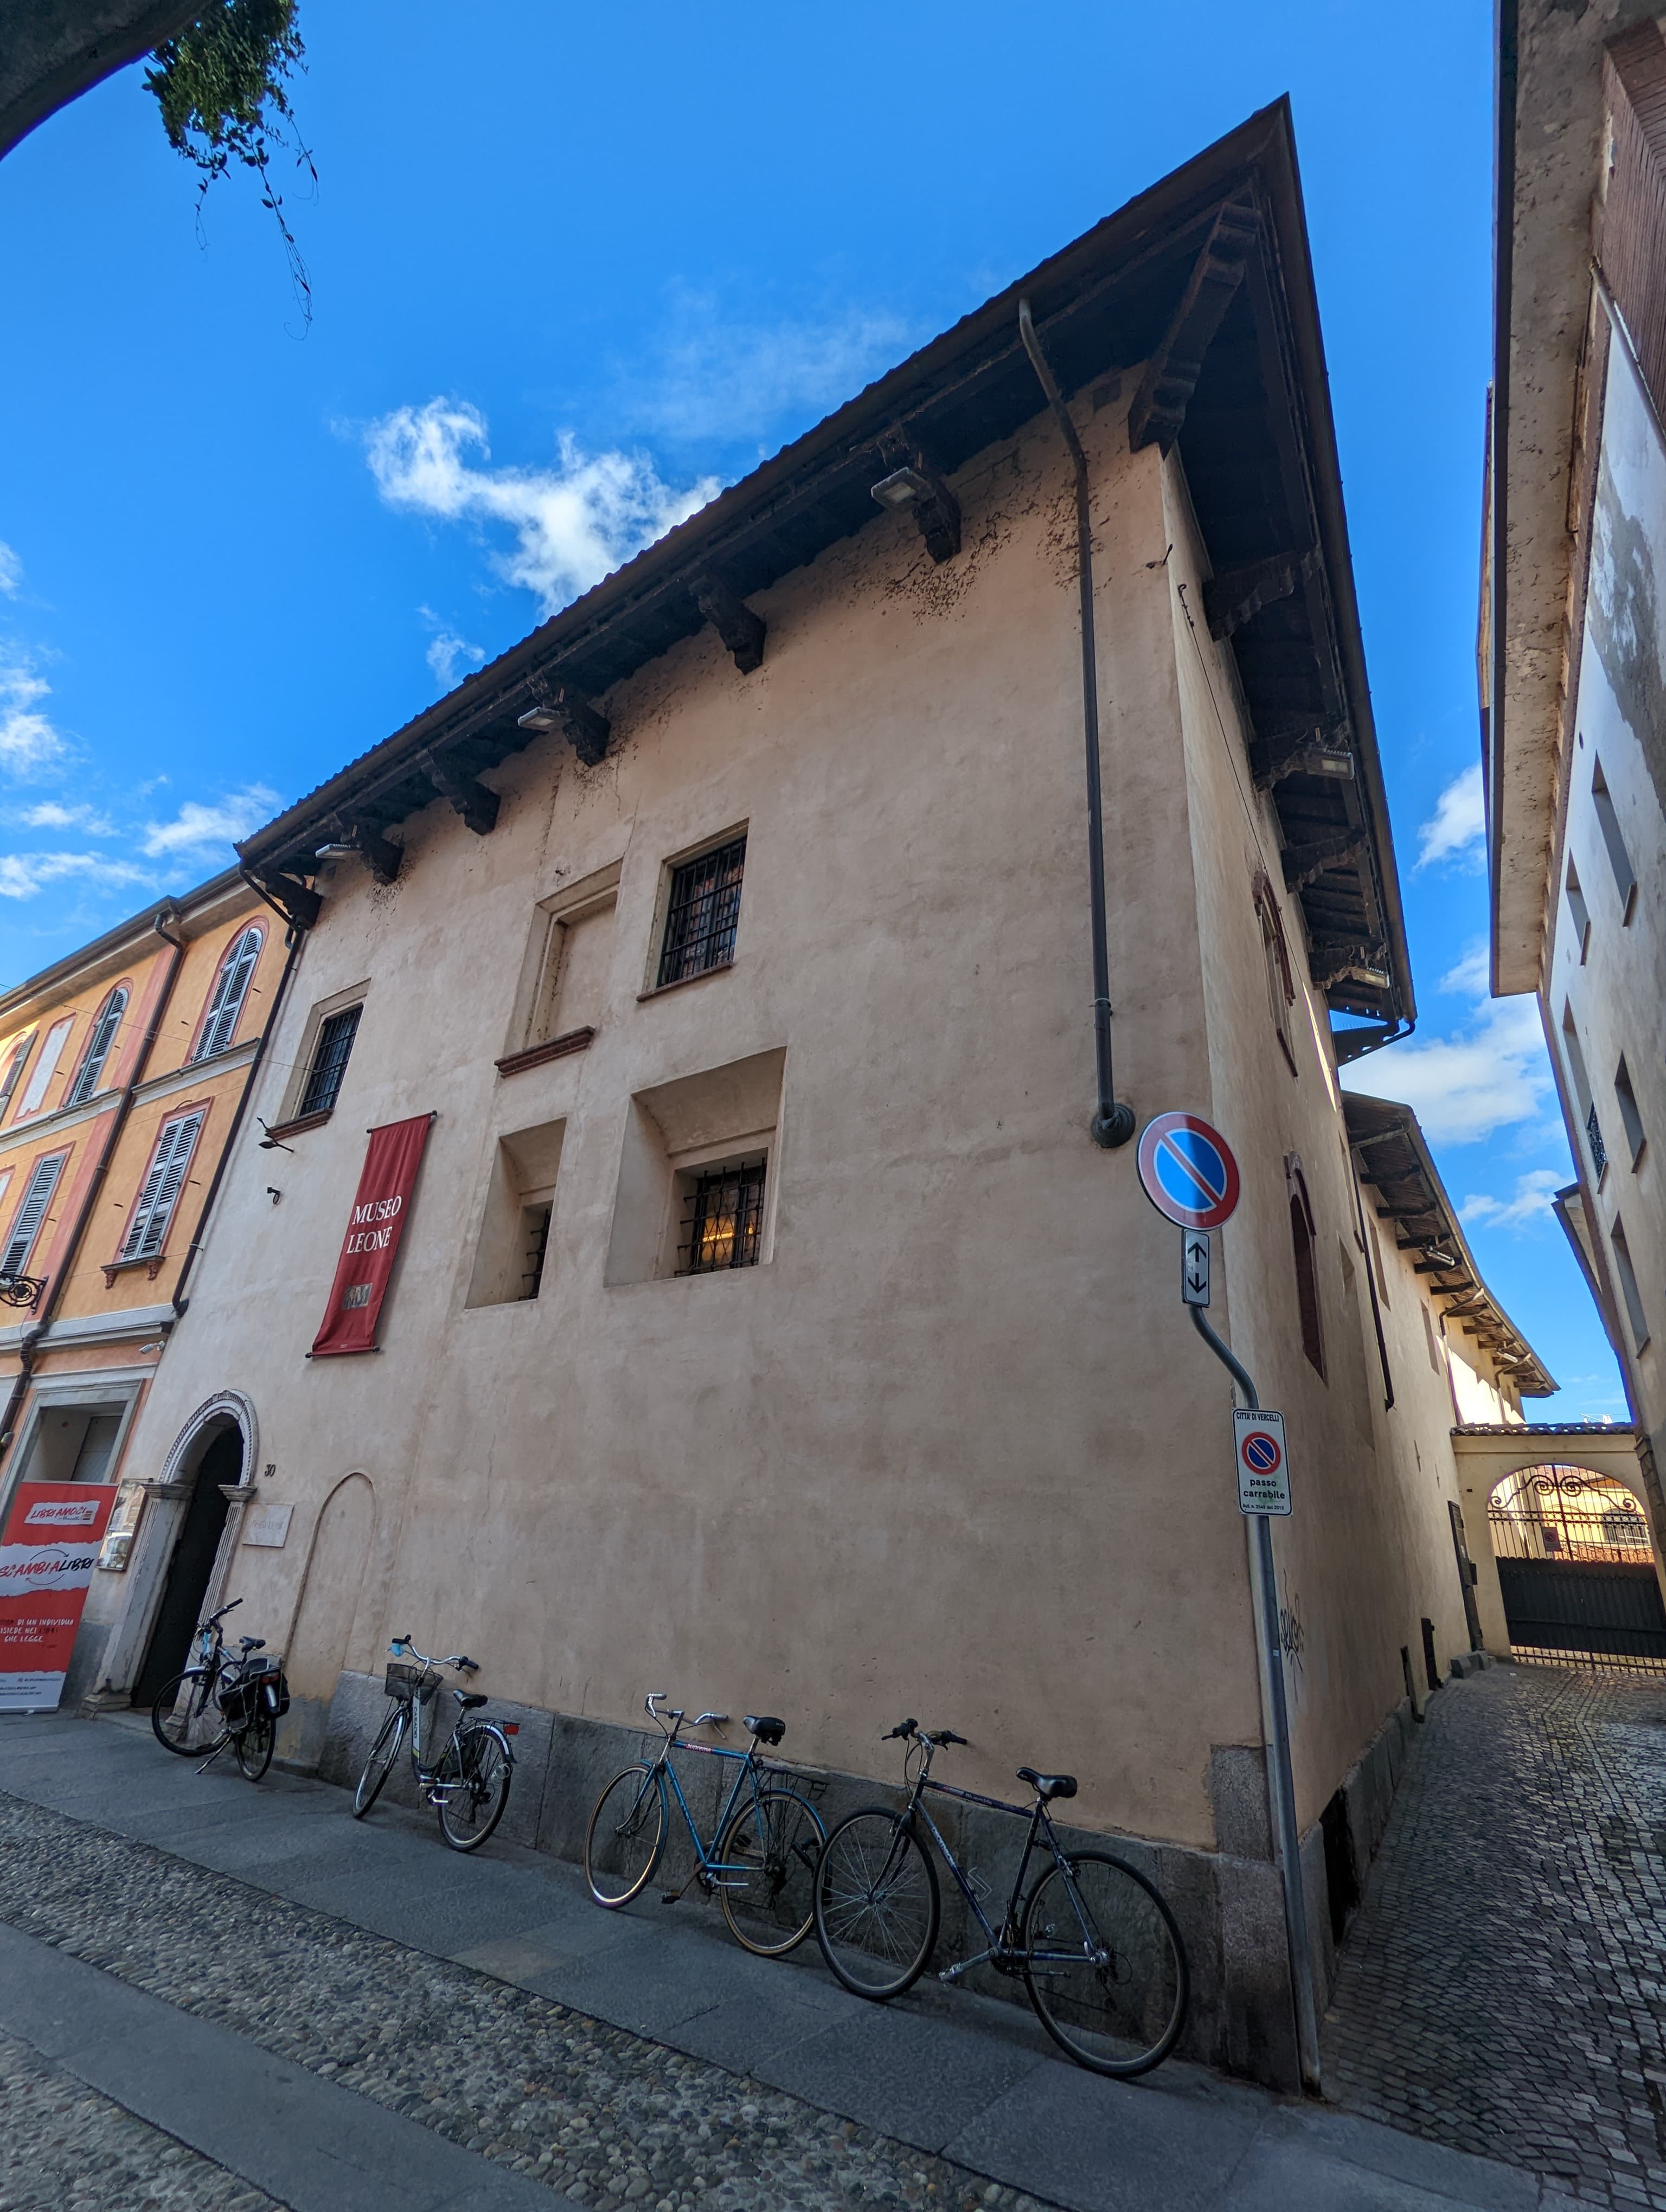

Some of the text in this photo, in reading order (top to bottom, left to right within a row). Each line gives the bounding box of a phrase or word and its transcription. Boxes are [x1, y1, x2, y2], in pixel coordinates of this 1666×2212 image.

[351, 1195, 402, 1225] MUSEO
[346, 1226, 393, 1254] LEONE
[1236, 1412, 1250, 1420] CITTA'
[1258, 1413, 1279, 1422] VERCELLI
[264, 1464, 275, 1476] 30
[1244, 1490, 1285, 1499] carrabile
[30, 1506, 87, 1519] LIBRIAMOCI
